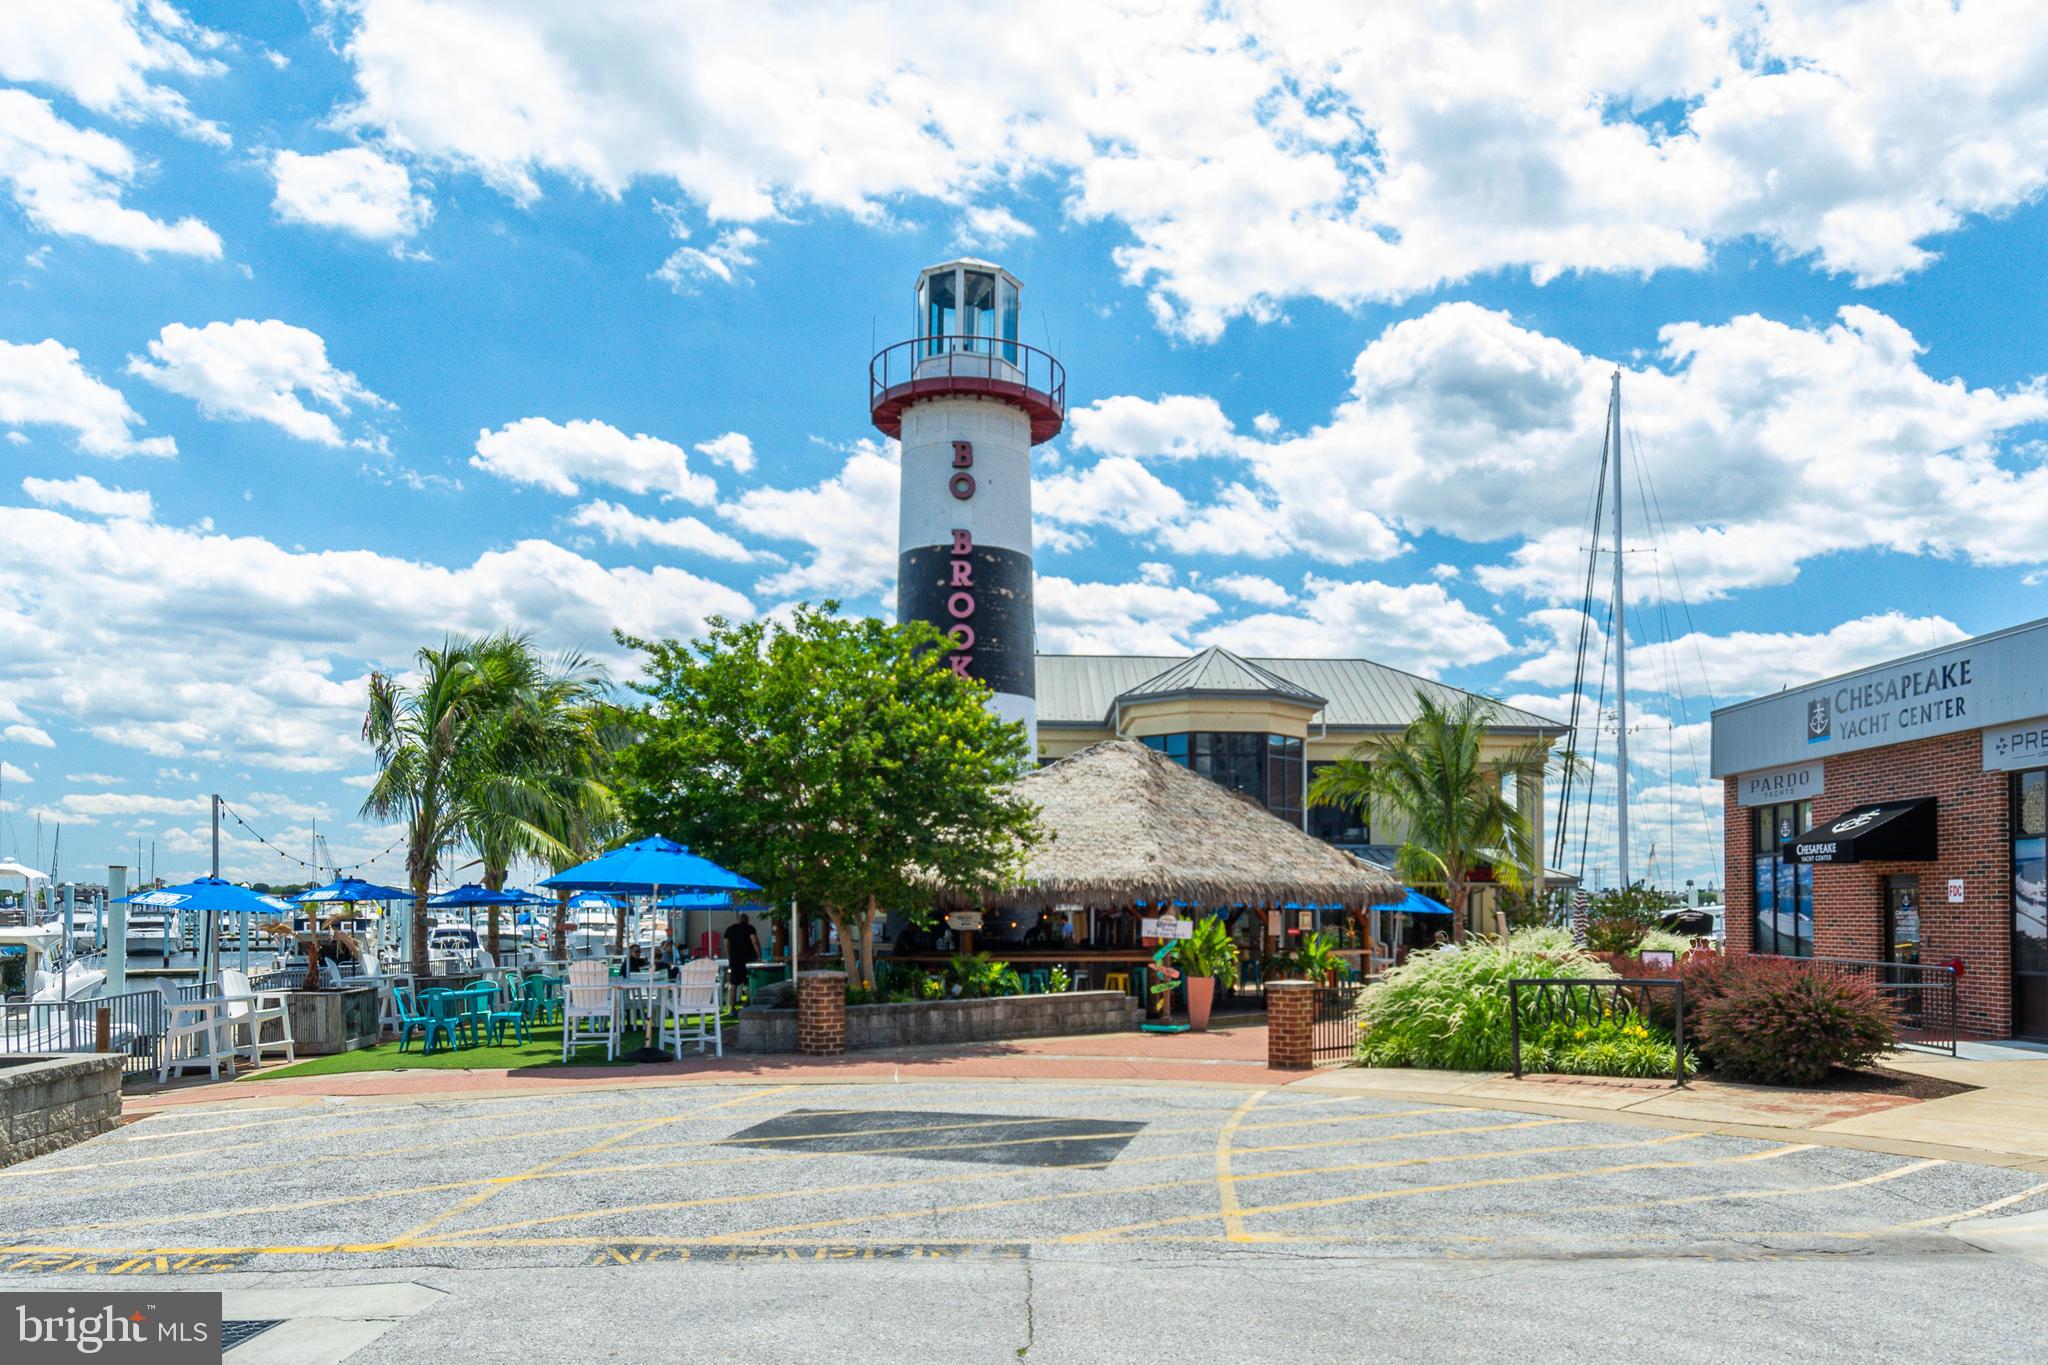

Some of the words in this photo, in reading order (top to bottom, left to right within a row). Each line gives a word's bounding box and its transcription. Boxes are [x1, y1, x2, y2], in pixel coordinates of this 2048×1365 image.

[949, 440, 976, 500] BO
[1835, 659, 1972, 714] CHESAPEAKE
[1840, 712, 1890, 740] YACHT
[1899, 696, 1966, 728] CENTER
[1751, 770, 1810, 794] PARDO
[1796, 842, 1838, 856] CHESAPEAKE
[1801, 854, 1814, 862] YACHT
[1815, 854, 1832, 862] CENTER
[1949, 885, 1963, 897] FDC
